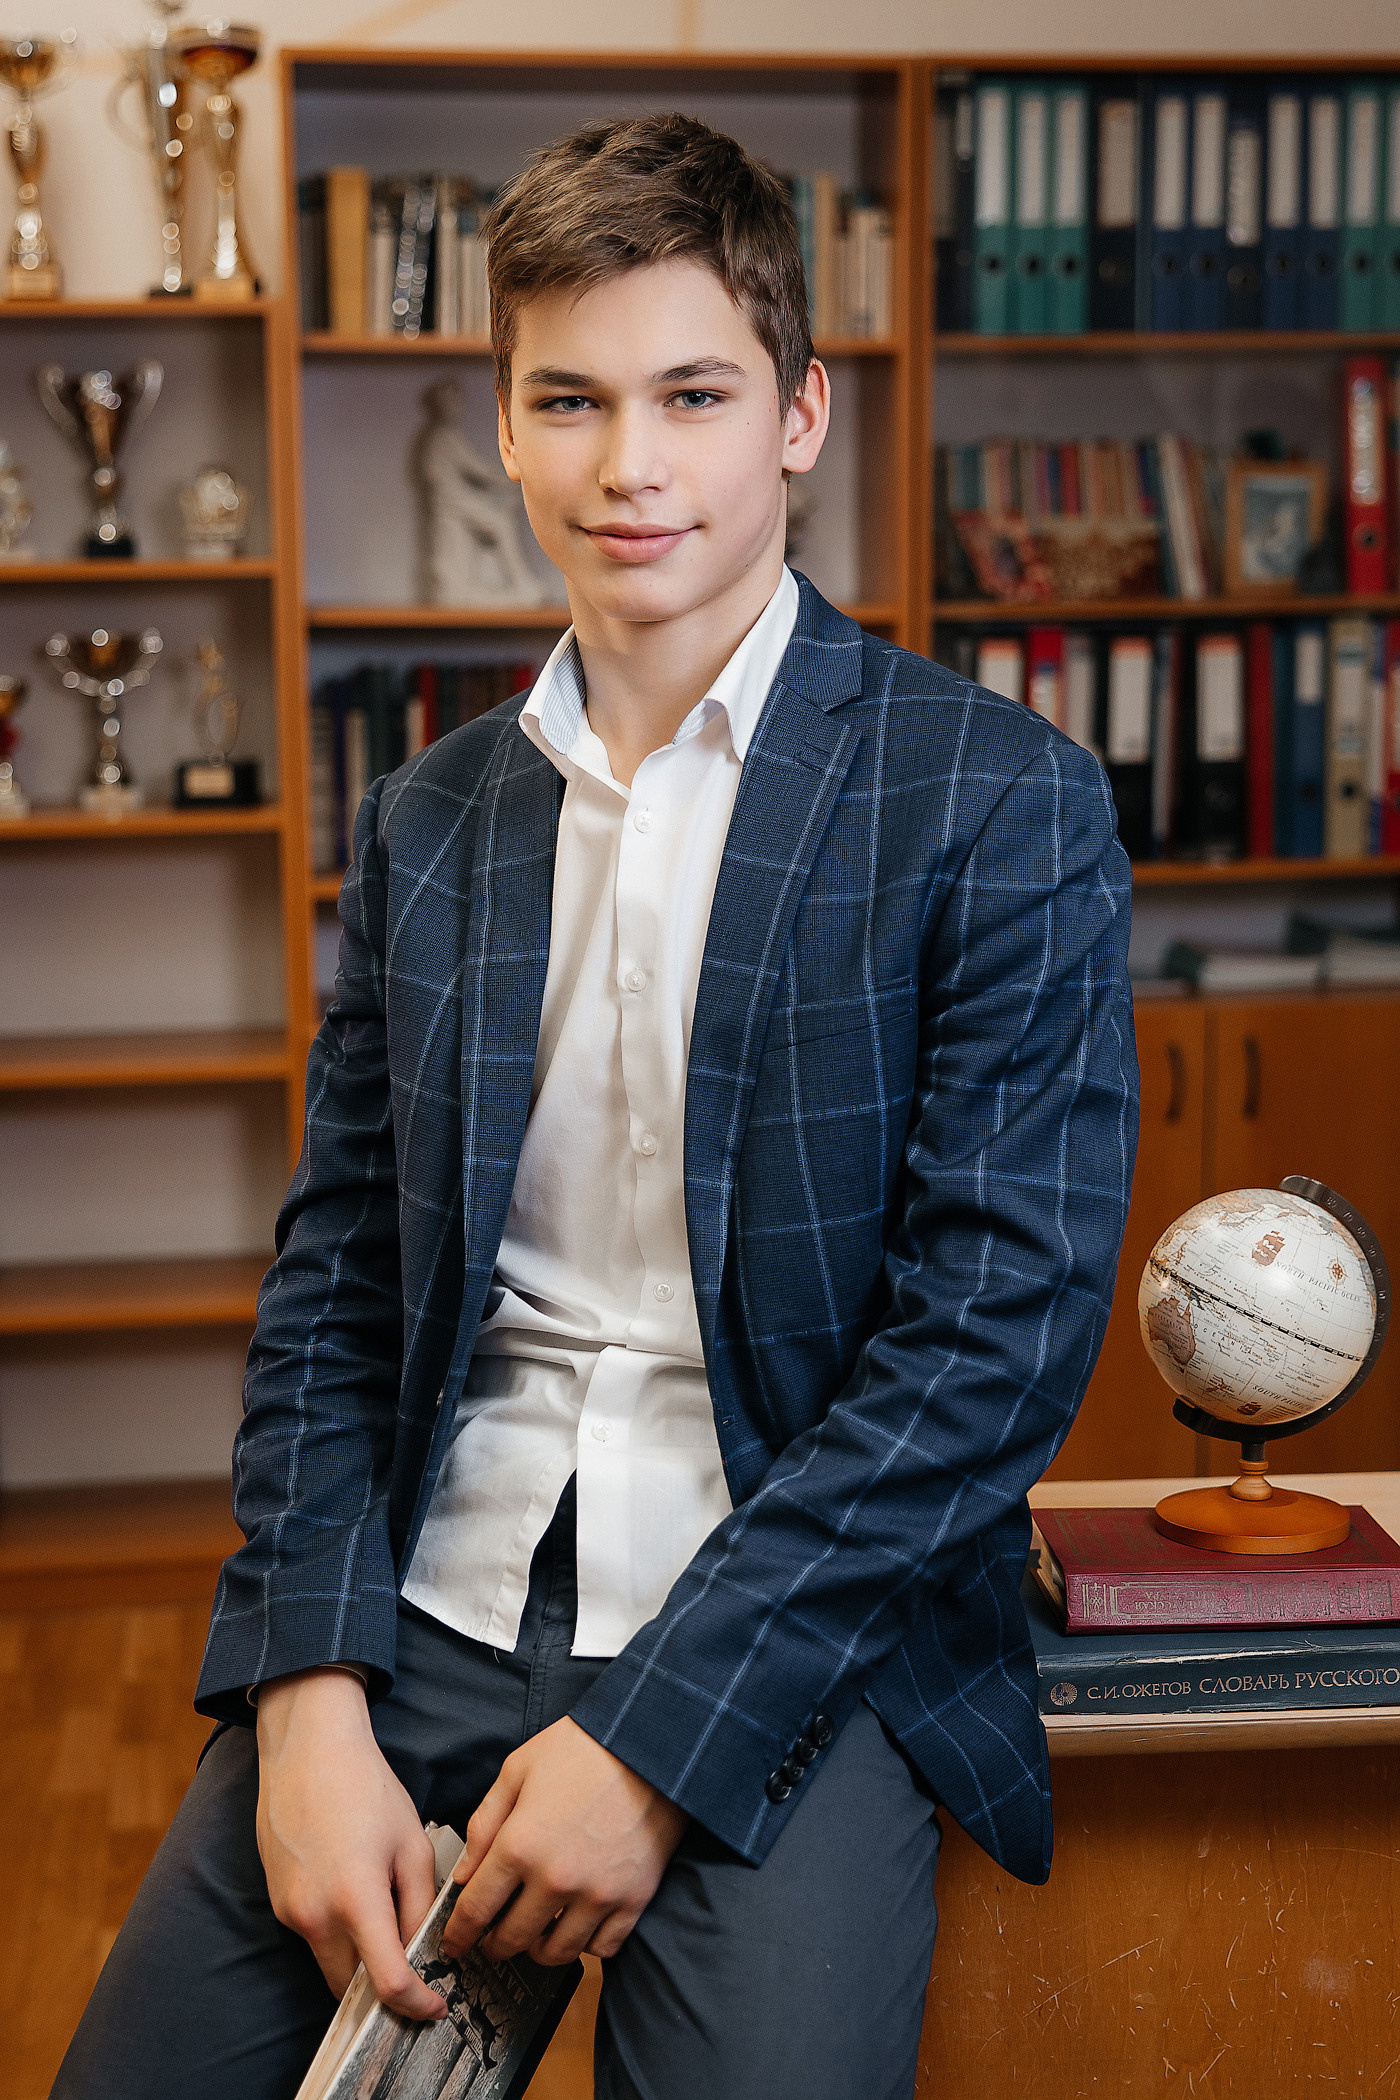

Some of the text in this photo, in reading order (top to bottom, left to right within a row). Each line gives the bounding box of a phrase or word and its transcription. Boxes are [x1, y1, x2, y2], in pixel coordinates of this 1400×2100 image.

[1308, 1277, 1339, 1295] PACIFIC
[1199, 1673, 1290, 1694] СЛОВАРЬ
[1294, 1667, 1400, 1689] РУССКОГО
